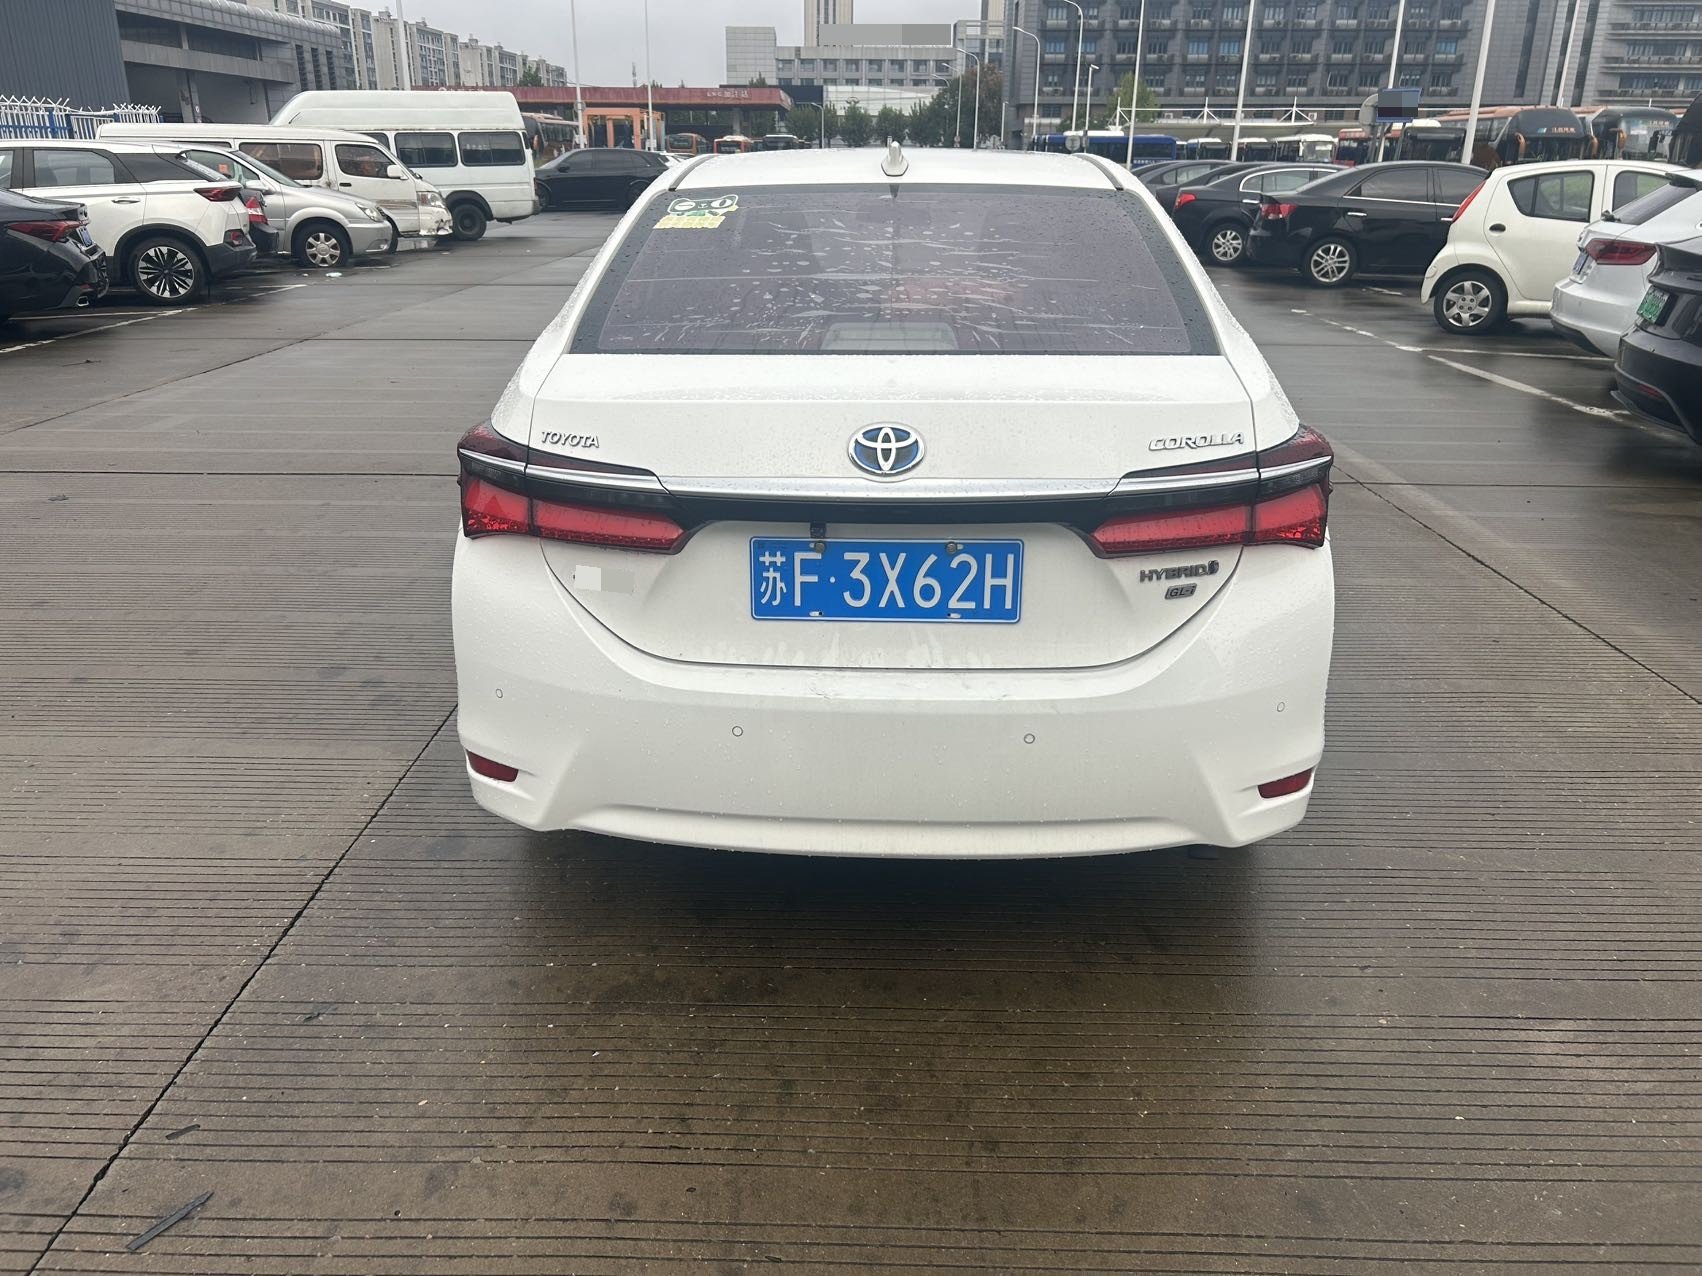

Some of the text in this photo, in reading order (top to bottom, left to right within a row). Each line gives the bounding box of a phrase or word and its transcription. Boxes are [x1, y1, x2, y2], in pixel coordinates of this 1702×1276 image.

[541, 431, 600, 448] TOYOTA
[1148, 432, 1244, 451] COROLLA
[759, 551, 1015, 610] 苏F·3X62H
[1139, 563, 1208, 582] HYBRID
[1169, 585, 1196, 597] GL-i
